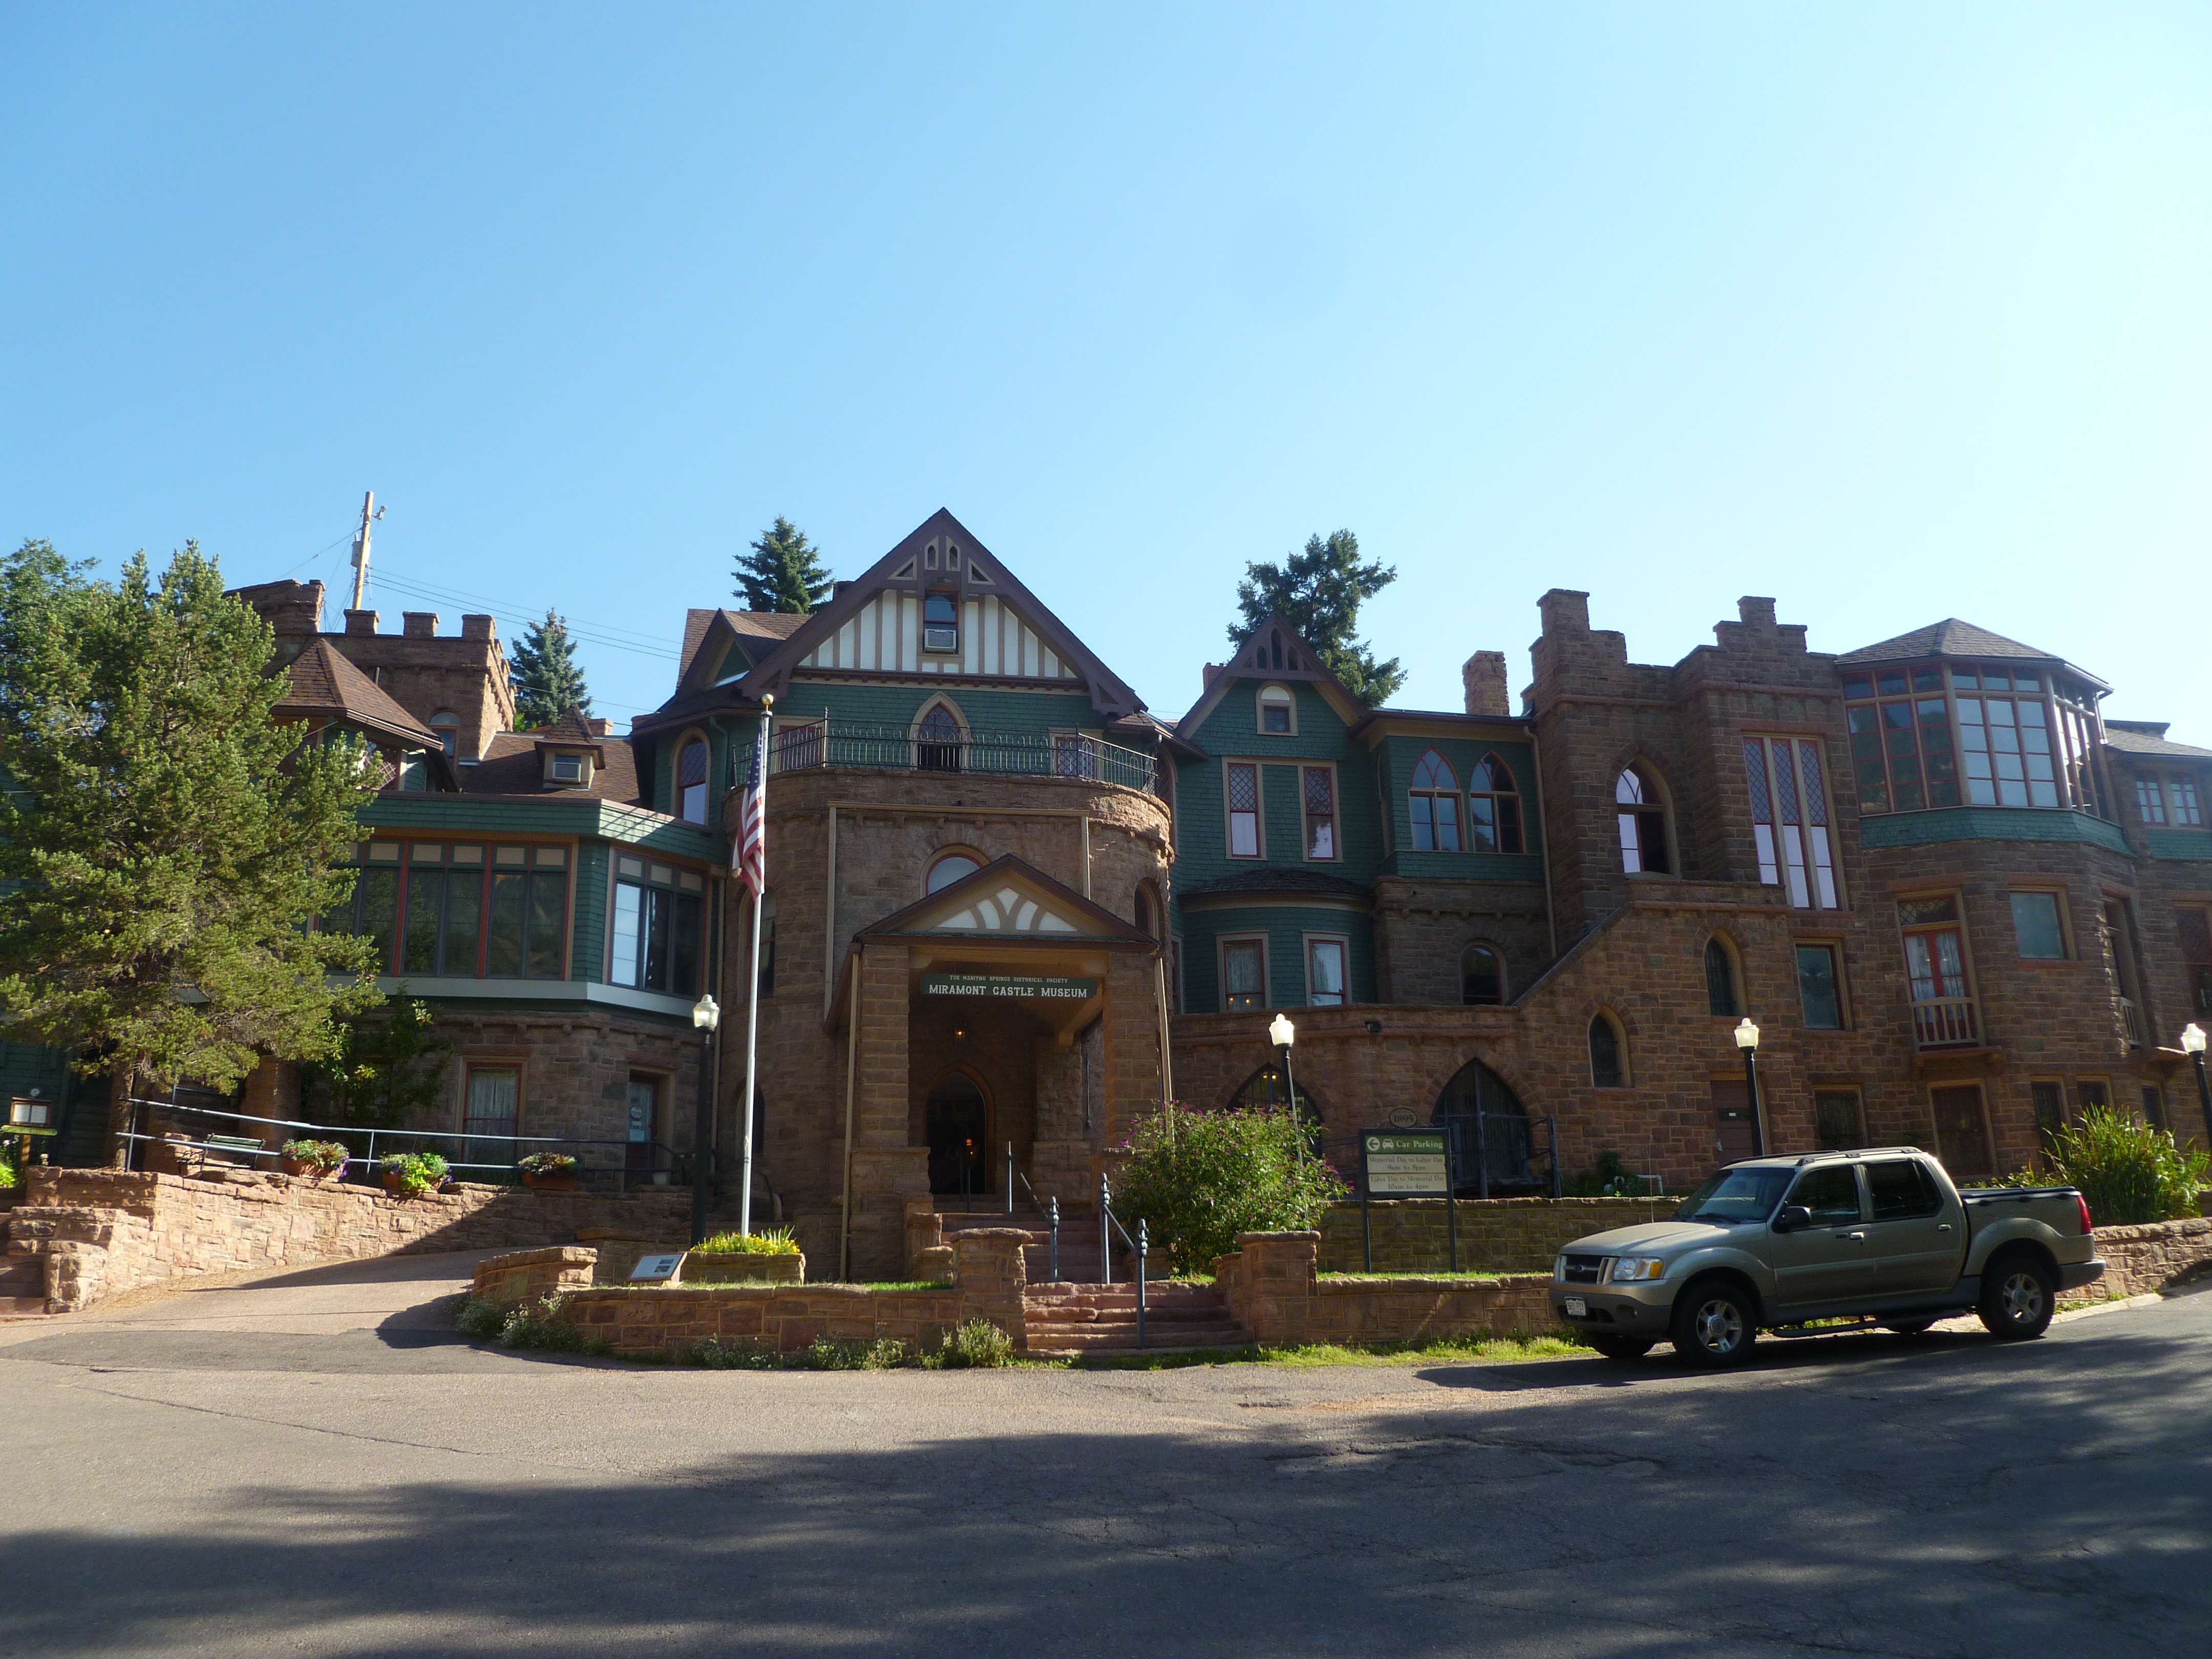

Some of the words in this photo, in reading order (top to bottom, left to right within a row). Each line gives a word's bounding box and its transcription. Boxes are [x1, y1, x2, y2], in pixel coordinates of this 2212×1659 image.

[929, 984, 987, 995] MIRAMONT
[993, 986, 1034, 996] CASTLE
[1041, 987, 1087, 998] MUSEUM
[1394, 1114, 1413, 1122] 1895
[1413, 1140, 1443, 1149] Parking
[1396, 1156, 1406, 1165] Day
